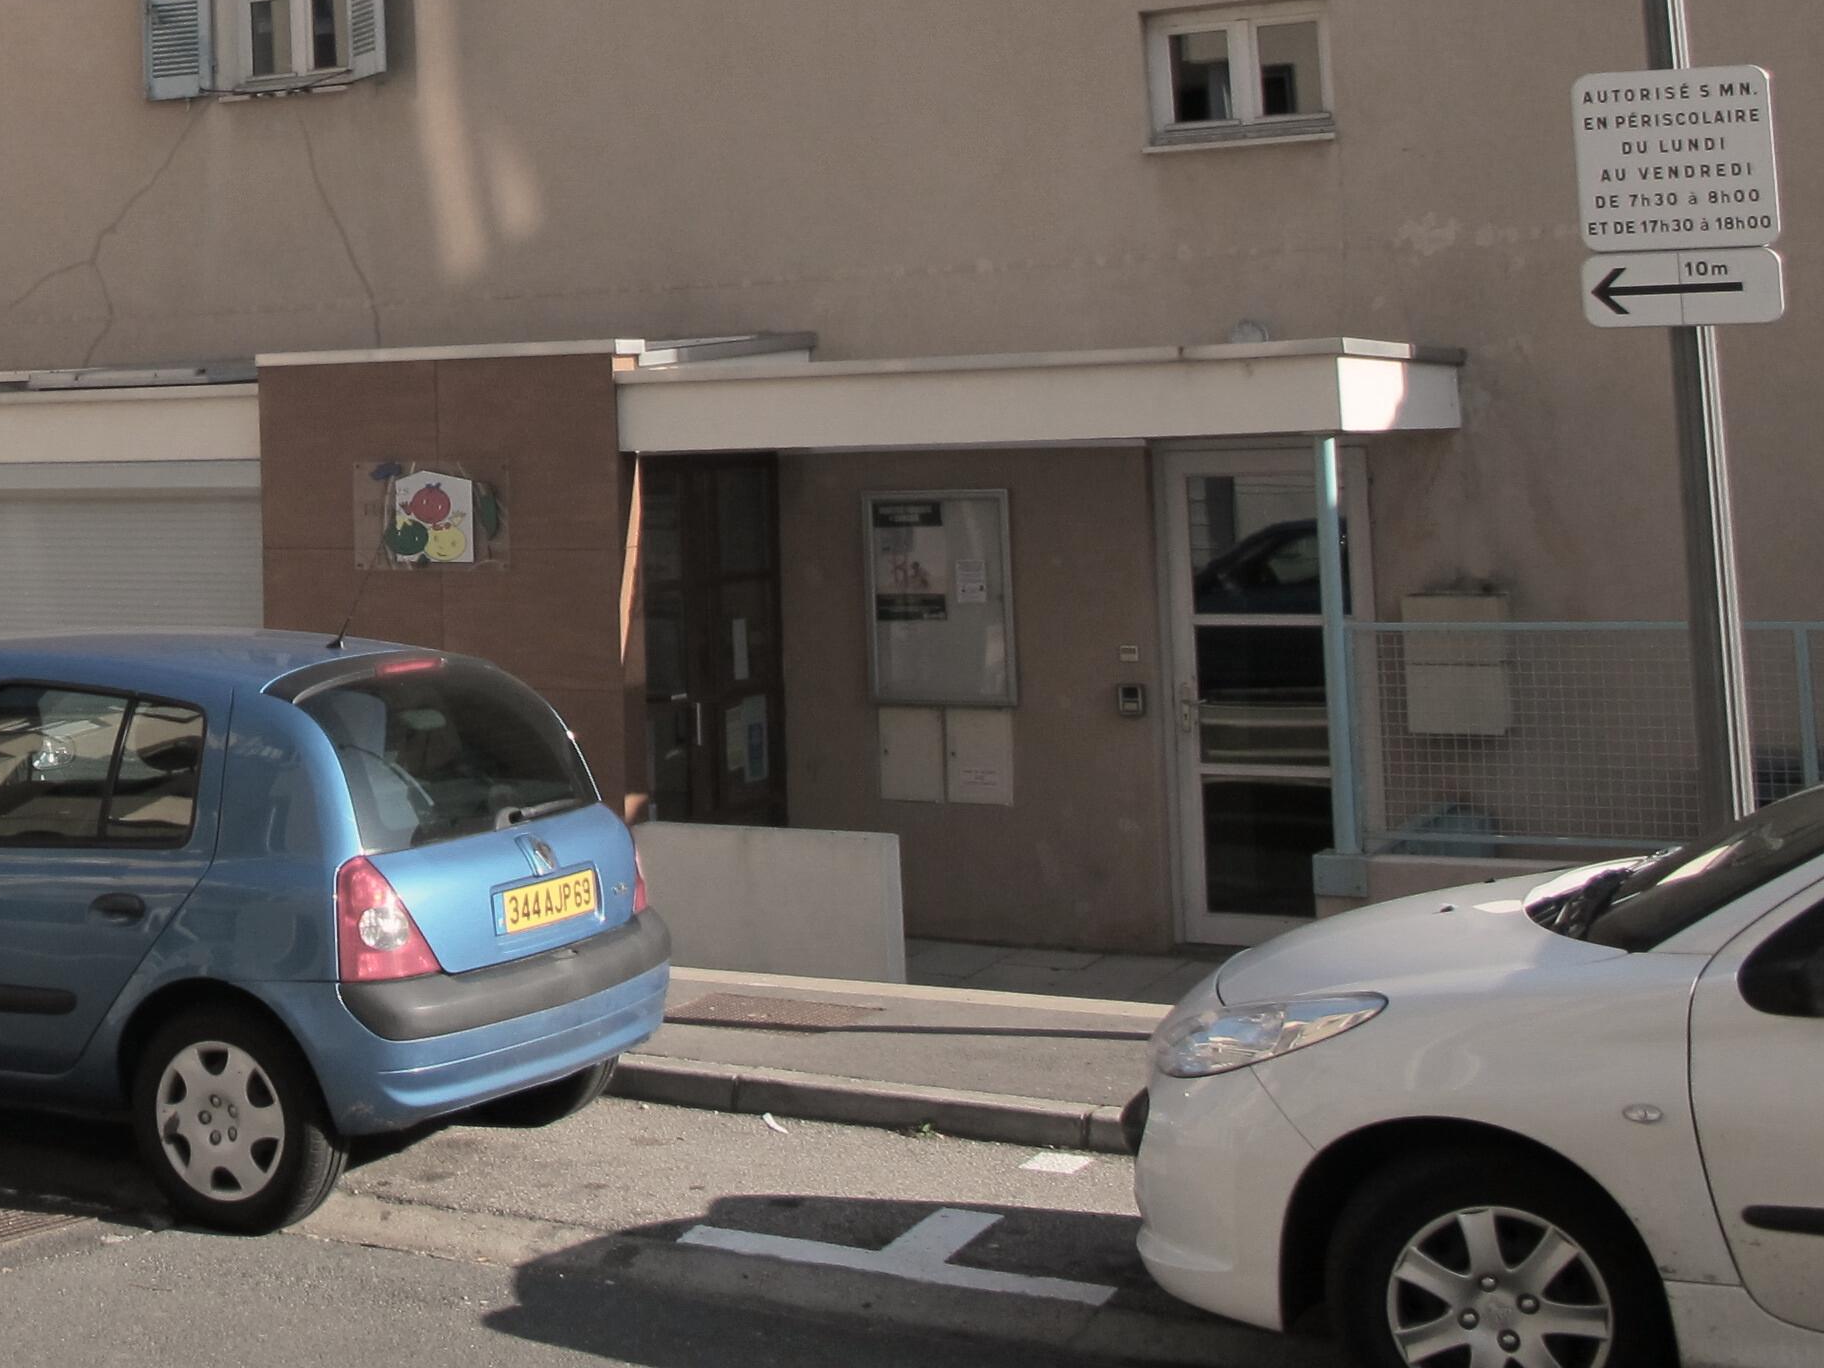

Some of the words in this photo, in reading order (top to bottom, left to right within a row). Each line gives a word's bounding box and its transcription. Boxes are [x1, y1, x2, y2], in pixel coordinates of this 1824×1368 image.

[1582, 83, 1690, 104] AUTORISÉ
[1583, 116, 1608, 130] EN
[1615, 108, 1760, 128] PÉRISCOLAIRE
[1622, 141, 1648, 155] DU
[1659, 137, 1725, 153] LUNDI
[1600, 168, 1626, 182] AU
[1638, 162, 1752, 180] VENDREDI
[1595, 195, 1619, 209] DE
[1629, 192, 1678, 208] 7h30
[1708, 189, 1760, 204] 8h00
[1588, 221, 1608, 236] ET
[1613, 220, 1636, 234] DE
[1641, 218, 1694, 233] 17h30
[1715, 215, 1772, 231] 18h00
[1684, 261, 1728, 277] 10m
